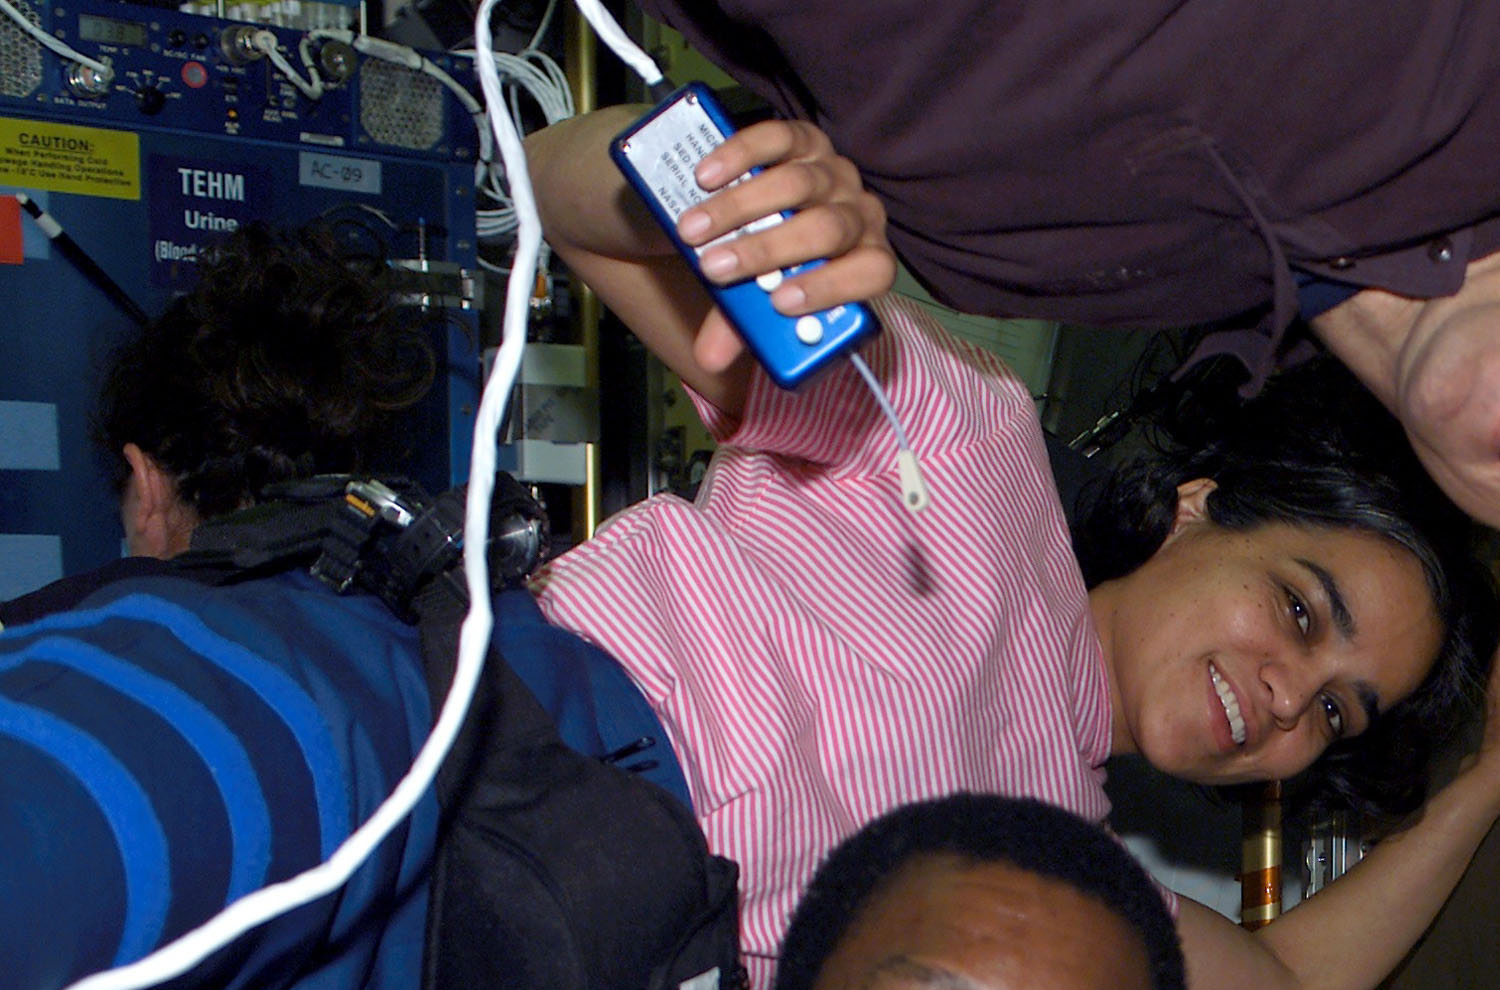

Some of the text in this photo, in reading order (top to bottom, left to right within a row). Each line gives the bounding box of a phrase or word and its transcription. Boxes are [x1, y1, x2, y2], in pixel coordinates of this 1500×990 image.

[18, 132, 95, 152] CAUTION:
[178, 167, 245, 201] TEHM
[660, 151, 689, 190] SERIAL
[658, 186, 682, 217] NASA
[184, 209, 240, 233] Urine
